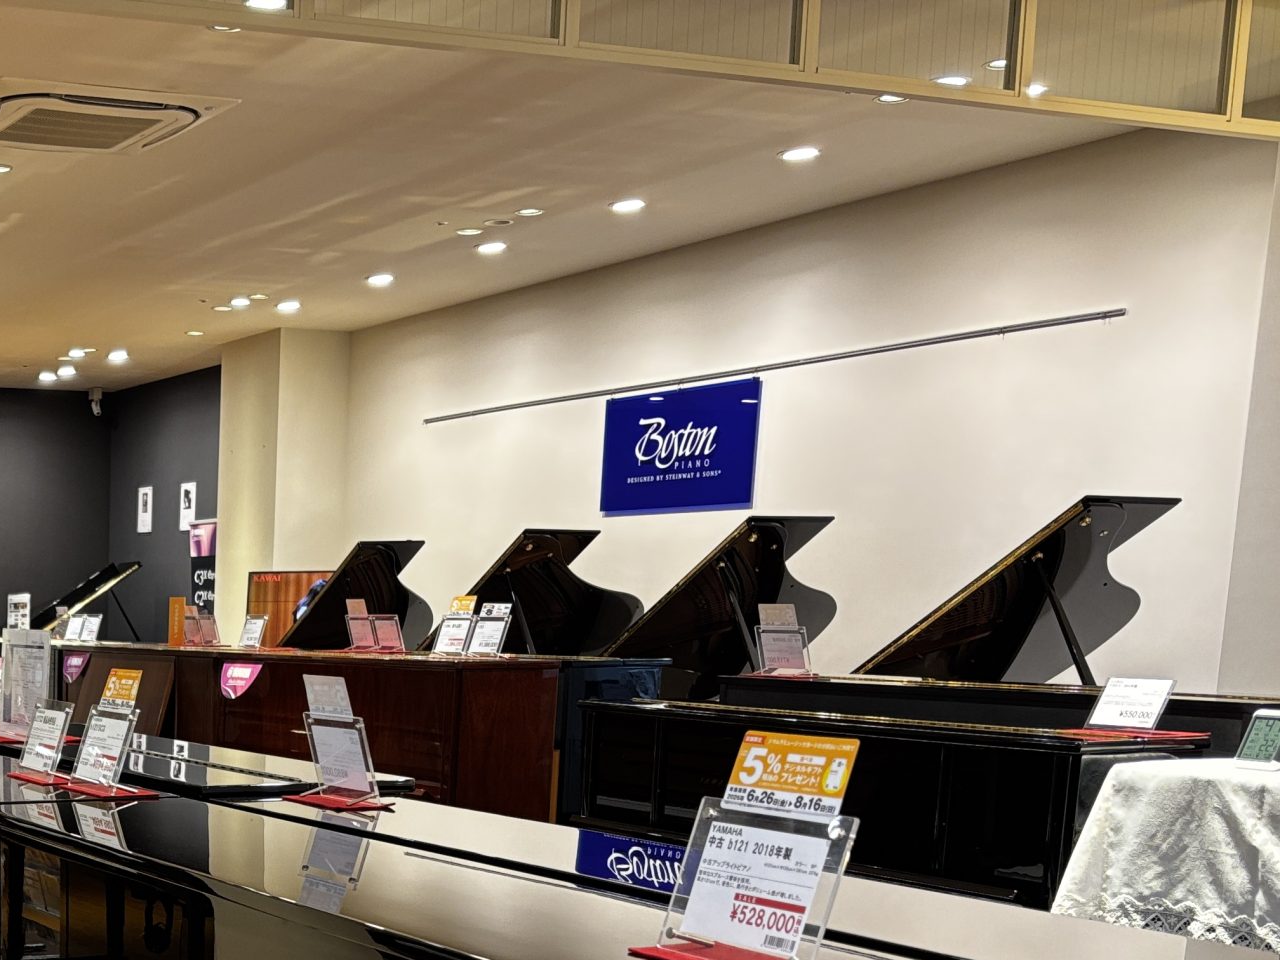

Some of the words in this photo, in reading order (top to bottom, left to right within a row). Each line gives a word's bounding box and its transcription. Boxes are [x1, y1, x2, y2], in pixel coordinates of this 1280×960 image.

[635, 417, 718, 469] Boston
[674, 458, 710, 470] PIANO
[627, 475, 654, 484] DESIGNED
[656, 474, 663, 482] BY
[665, 472, 694, 481] STEINWAY
[253, 574, 281, 583] KAWAI
[739, 747, 782, 785] 5%
[711, 823, 743, 837] YAMAHA
[708, 835, 725, 849] 中古
[728, 839, 749, 854] b121
[752, 842, 794, 861] 2018年製
[737, 894, 757, 904] SALE
[729, 902, 796, 934] ¥528,000
